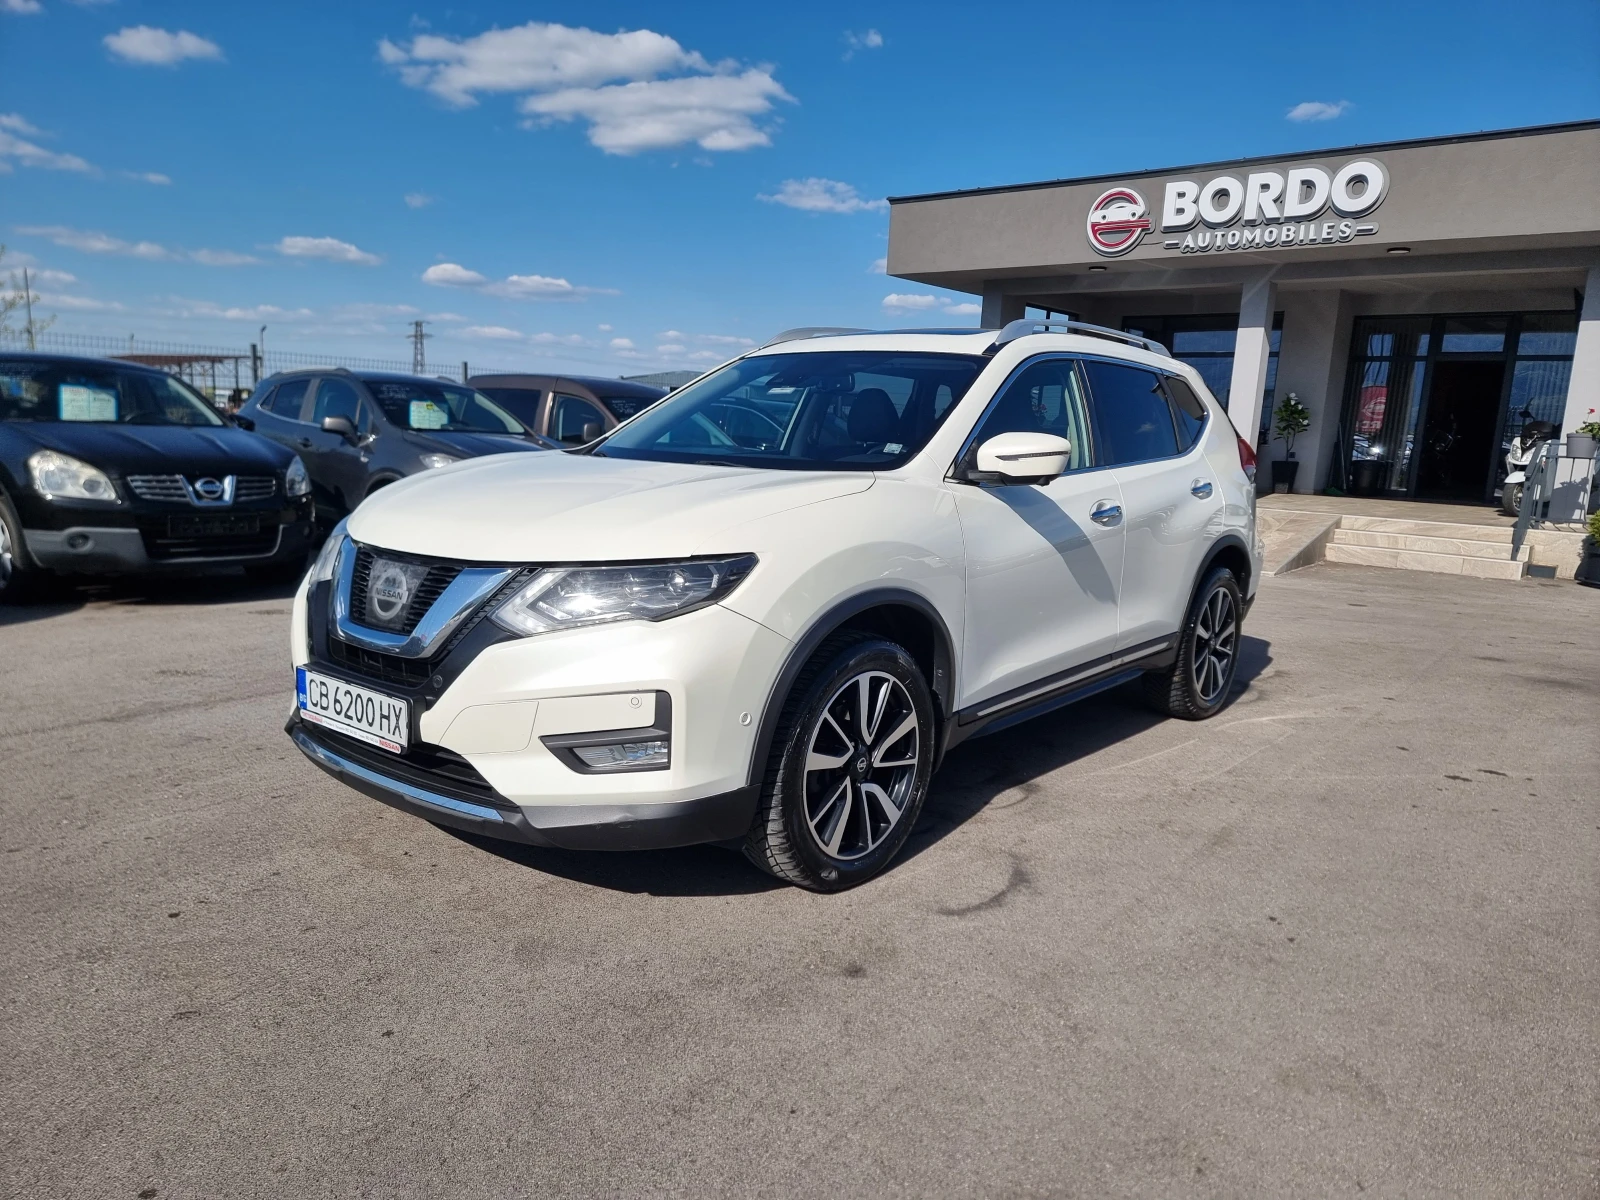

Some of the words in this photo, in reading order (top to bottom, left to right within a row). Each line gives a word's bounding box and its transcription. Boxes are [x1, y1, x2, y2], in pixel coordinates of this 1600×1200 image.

[1161, 161, 1386, 232] BORDO
[1181, 221, 1353, 250] AUTOMOBILES
[374, 587, 404, 601] NISSAN
[378, 738, 401, 753] NISSAN
